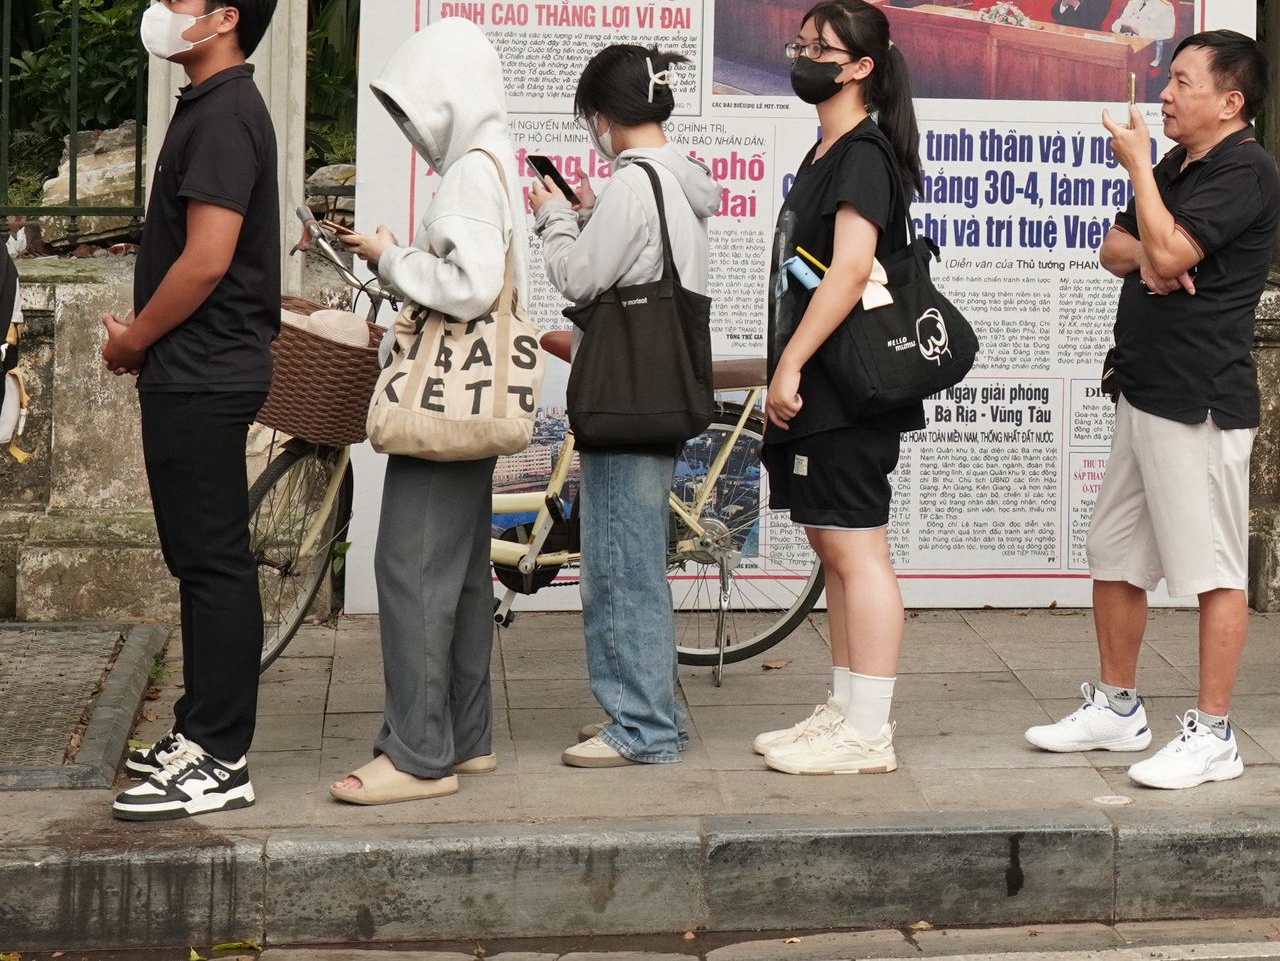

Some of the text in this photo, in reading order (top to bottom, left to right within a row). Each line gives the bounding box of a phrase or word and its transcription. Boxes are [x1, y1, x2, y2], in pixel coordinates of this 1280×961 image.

[491, 3, 528, 26] CAO
[535, 0, 596, 28] THẮNG
[602, 6, 630, 33] LỢI
[636, 4, 655, 29] VĨ
[660, 7, 691, 34] ĐẠI
[980, 129, 1033, 163] thần
[1040, 131, 1066, 163] và
[1072, 131, 1084, 167] ý
[712, 152, 766, 182] phố
[984, 170, 1095, 209] 30-4, làm
[954, 215, 980, 247] và
[986, 213, 1012, 247] trí
[1018, 216, 1058, 252] tuệ
[1064, 215, 1111, 253] Việt
[887, 337, 908, 347] HELLO
[946, 383, 1049, 405] Ngày giải phóng
[935, 405, 1051, 426] Bà Rịa Vũng Tàu
